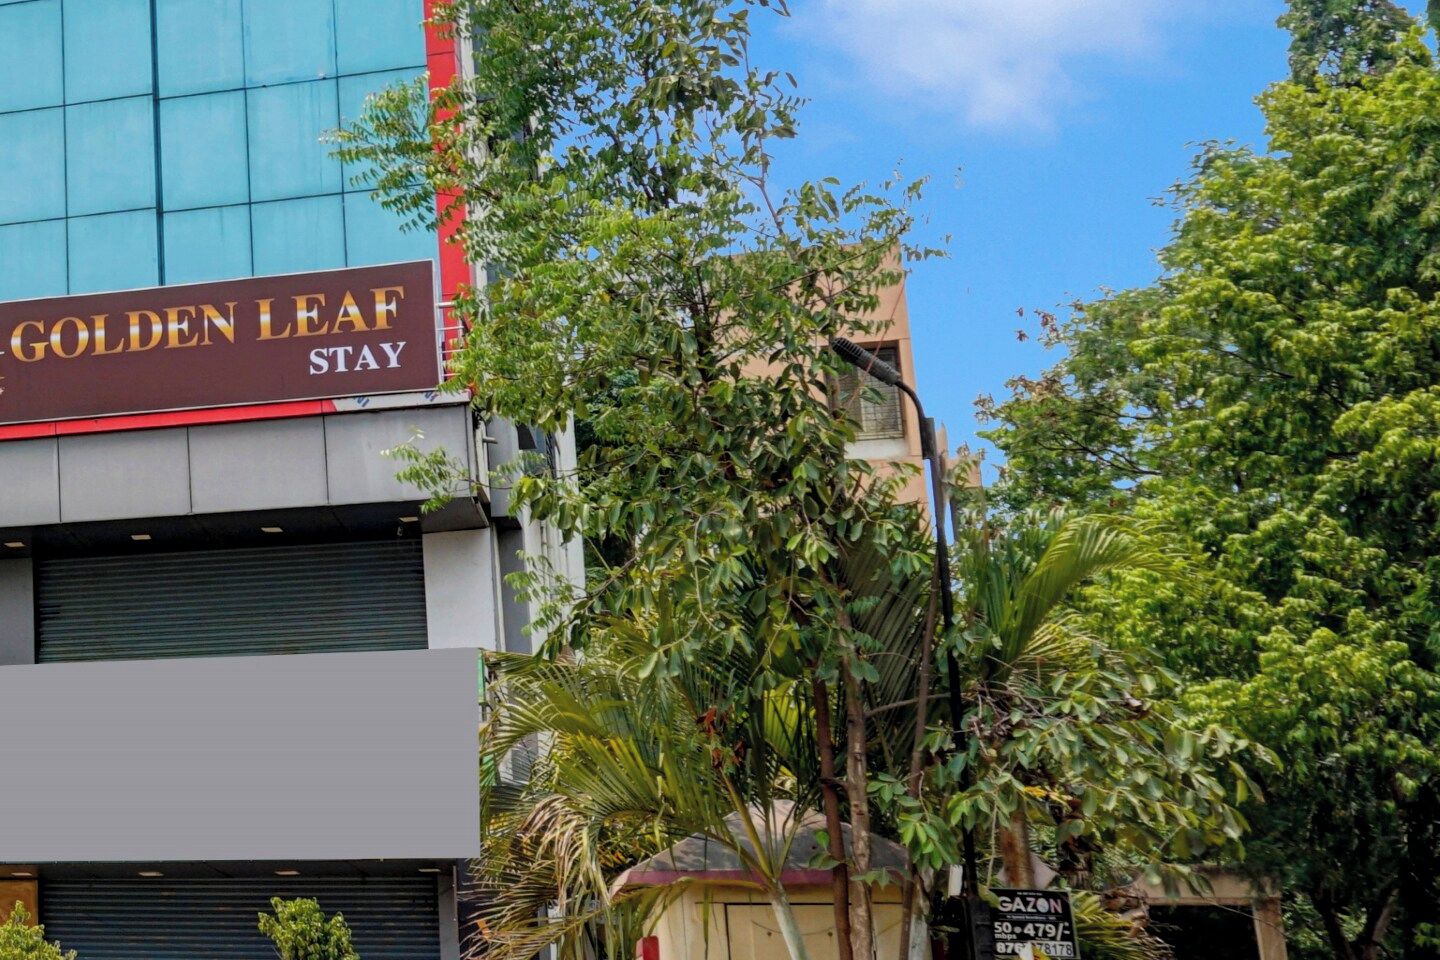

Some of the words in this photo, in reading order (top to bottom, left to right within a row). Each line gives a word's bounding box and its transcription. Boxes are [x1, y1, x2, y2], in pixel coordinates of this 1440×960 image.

[10, 301, 238, 363] GOLDEN
[255, 285, 405, 341] LEAF
[309, 341, 407, 375] STAY
[998, 896, 1063, 913] GAZON
[994, 921, 1012, 933] 50
[994, 932, 1017, 940] mbps
